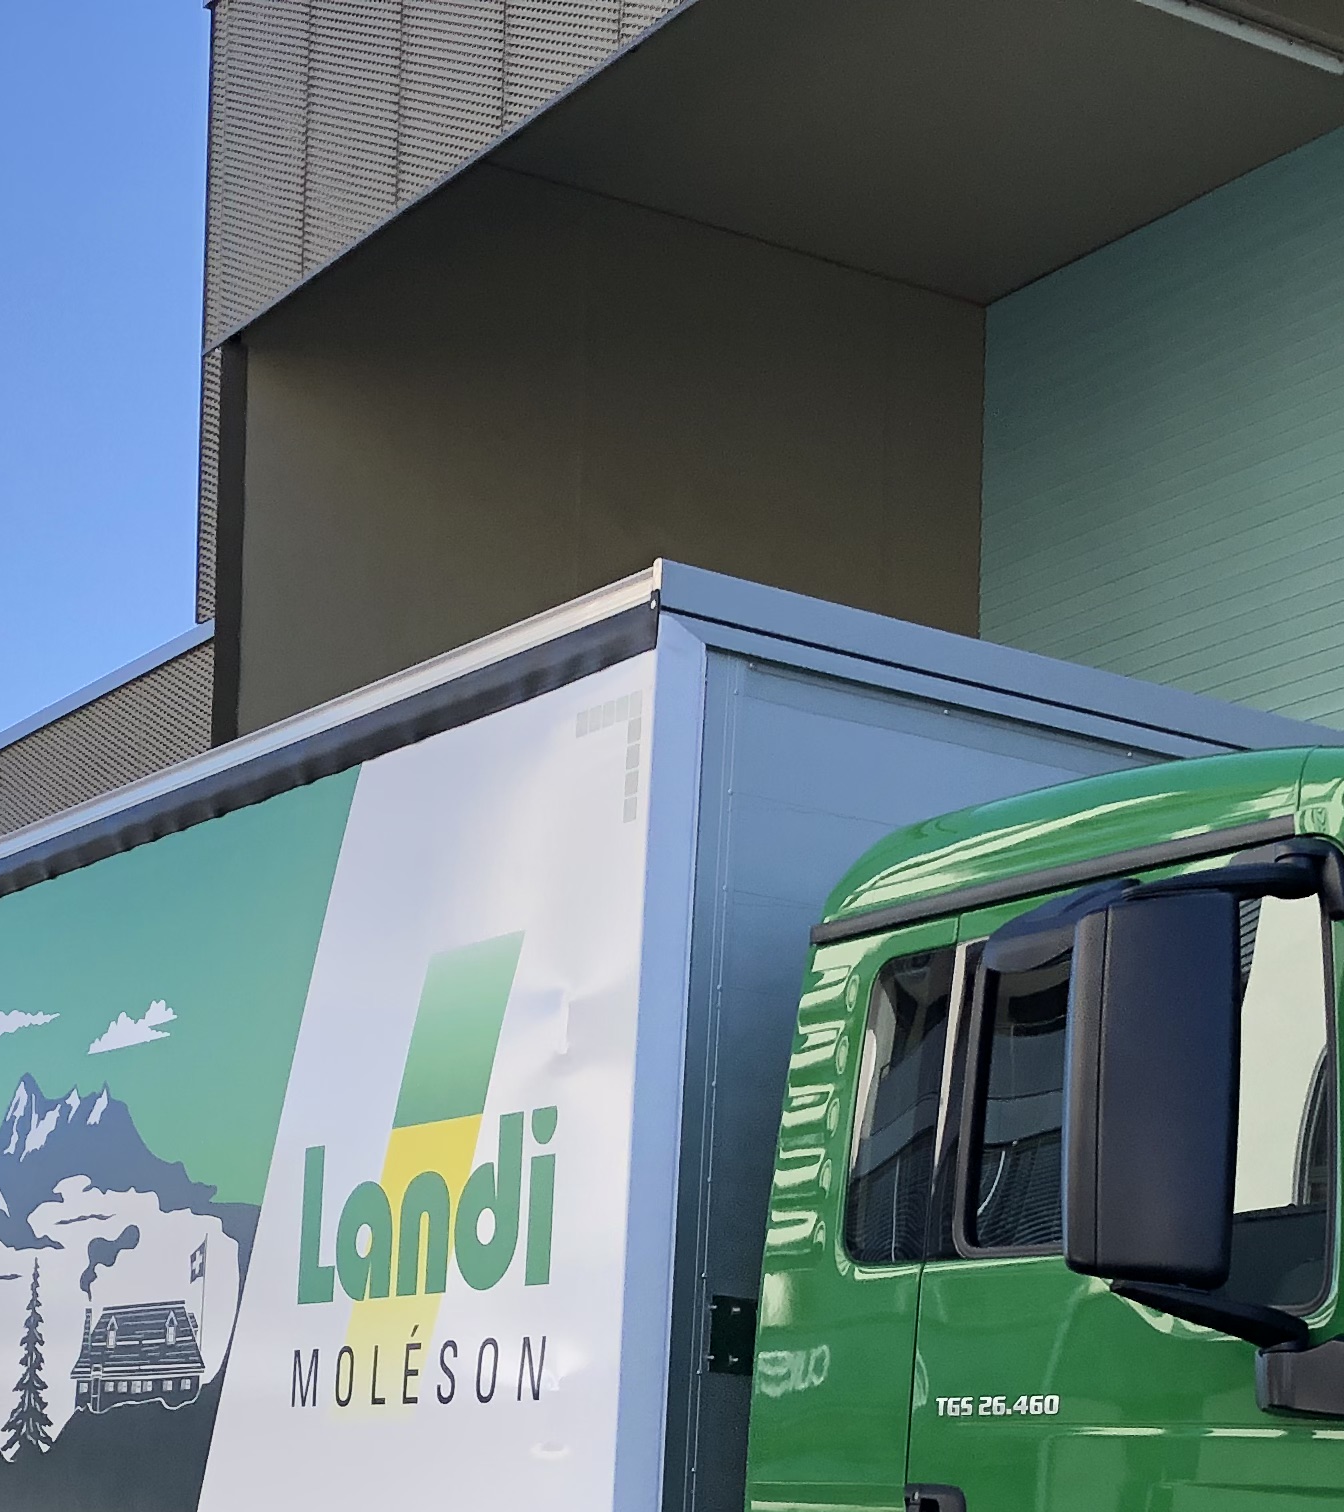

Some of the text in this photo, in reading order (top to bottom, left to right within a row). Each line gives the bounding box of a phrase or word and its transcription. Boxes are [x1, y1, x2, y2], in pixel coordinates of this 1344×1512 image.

[297, 1105, 558, 1305] Landi
[291, 1324, 547, 1408] MOLÉSON
[935, 1395, 1060, 1417] TGS 26.460
